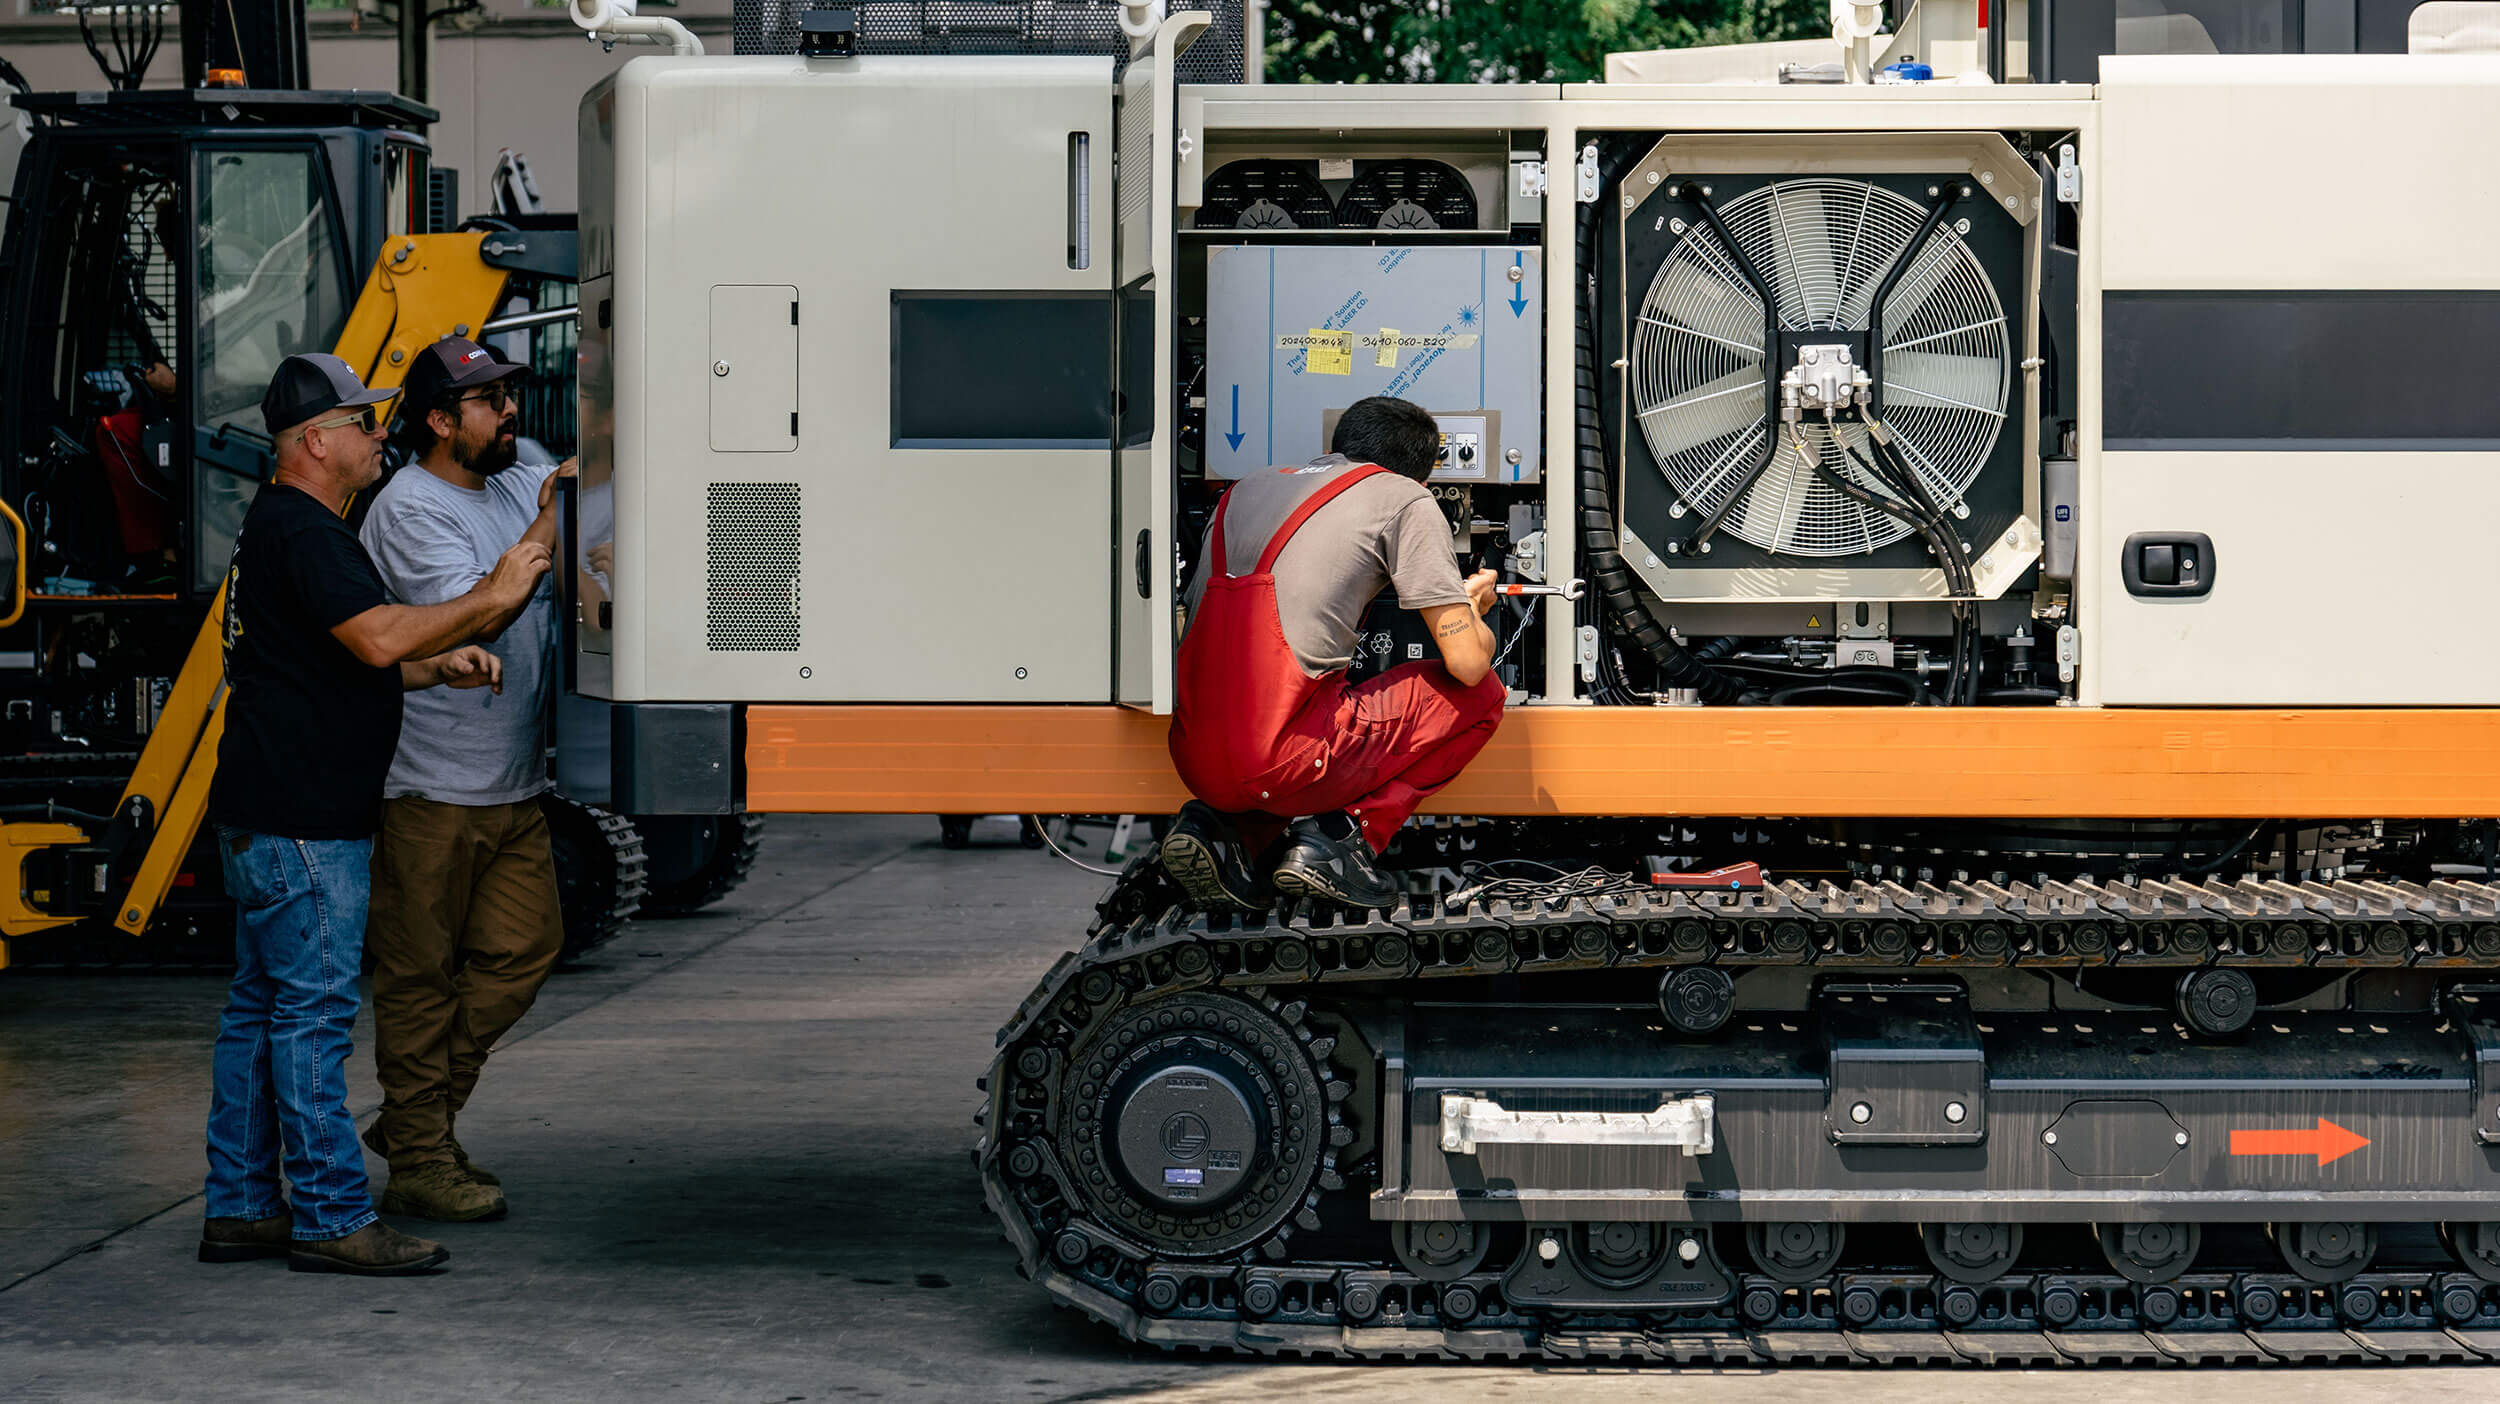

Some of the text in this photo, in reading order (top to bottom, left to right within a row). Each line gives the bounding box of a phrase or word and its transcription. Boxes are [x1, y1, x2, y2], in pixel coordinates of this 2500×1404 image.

[1286, 290, 1362, 368] The Solution
[1338, 308, 1358, 328] LASER
[1387, 352, 1425, 391] Fiber LASER
[1349, 661, 1363, 669] Pb
